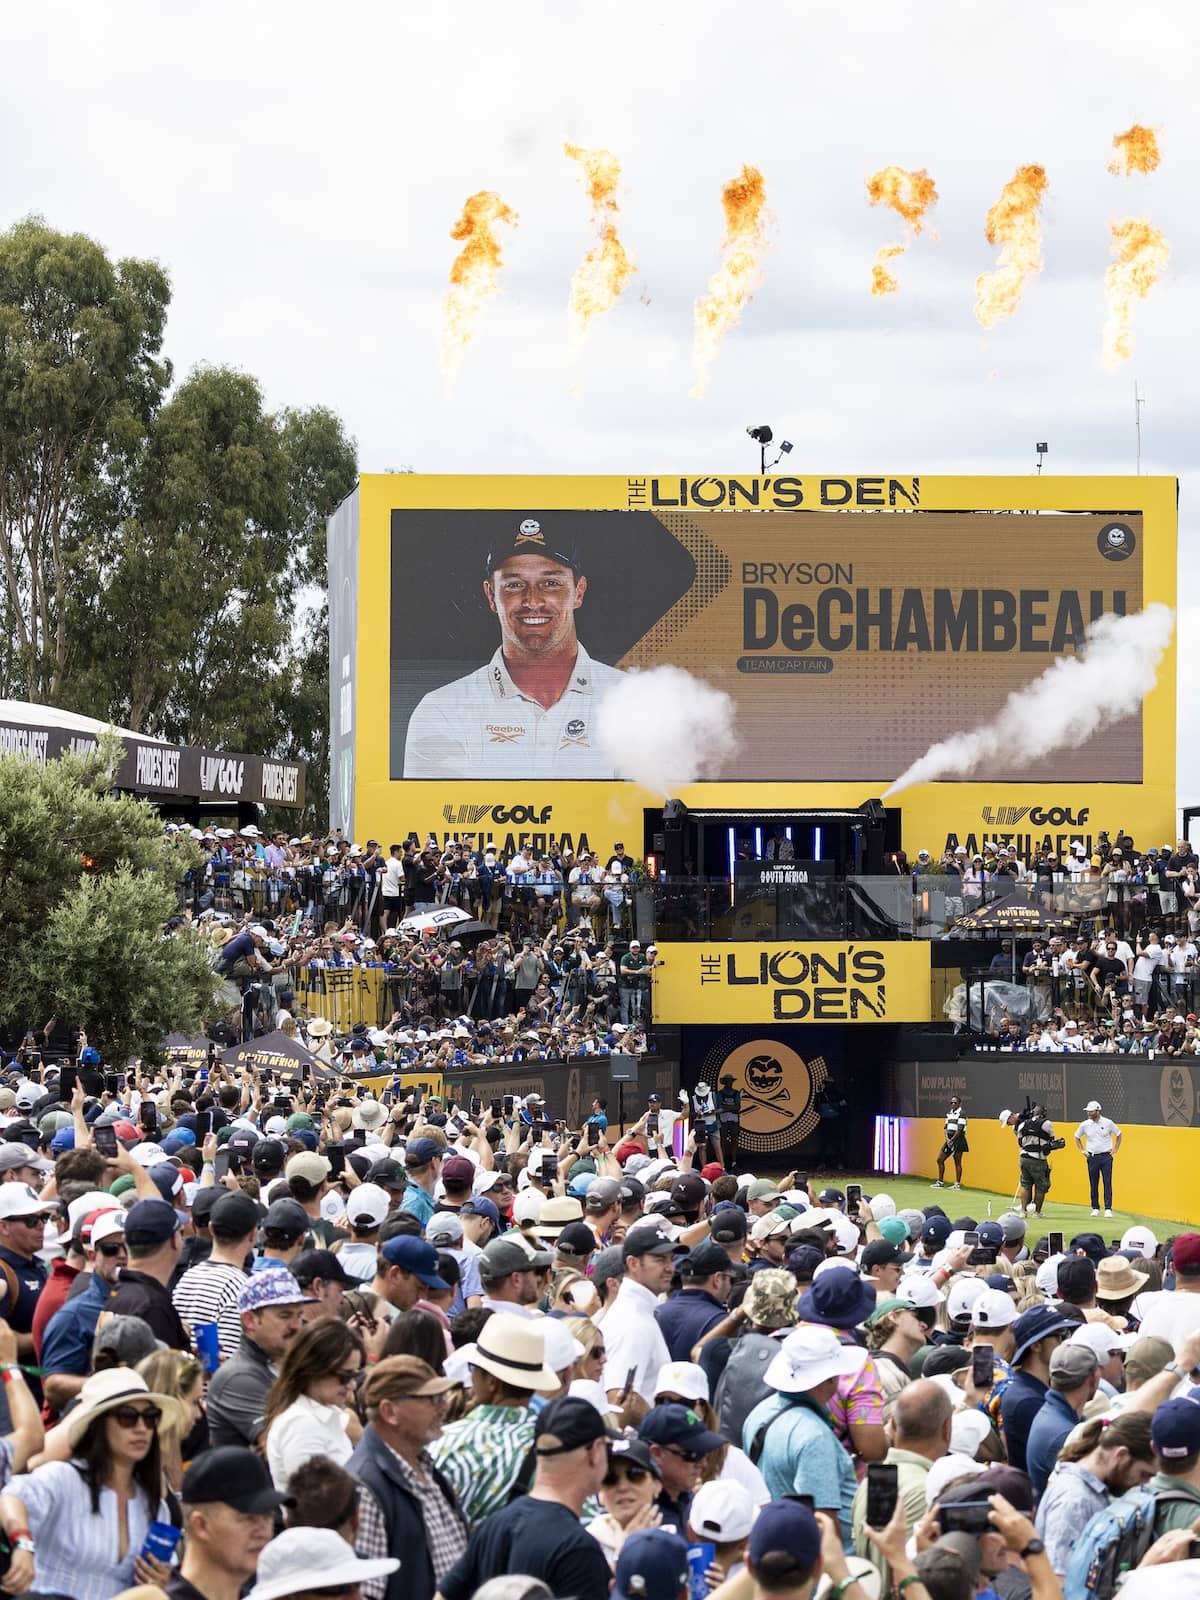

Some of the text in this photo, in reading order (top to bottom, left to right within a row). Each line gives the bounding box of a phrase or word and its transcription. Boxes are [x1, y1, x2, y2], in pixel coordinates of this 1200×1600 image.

[628, 477, 920, 507] THE LION'S DEN
[742, 563, 854, 585] BRYSON
[744, 660, 828, 671] TEAM CAPTAIN
[486, 725, 526, 734] Reebok
[136, 746, 181, 788] PRIDES NEST
[261, 762, 299, 802] PRIDES NEST
[760, 871, 808, 883] SOUTH AFRICA
[701, 945, 886, 986] THE LION'S
[773, 985, 886, 1019] DEN
[269, 1054, 299, 1069] AFRICA
[921, 1077, 966, 1089] NOW PLAYING
